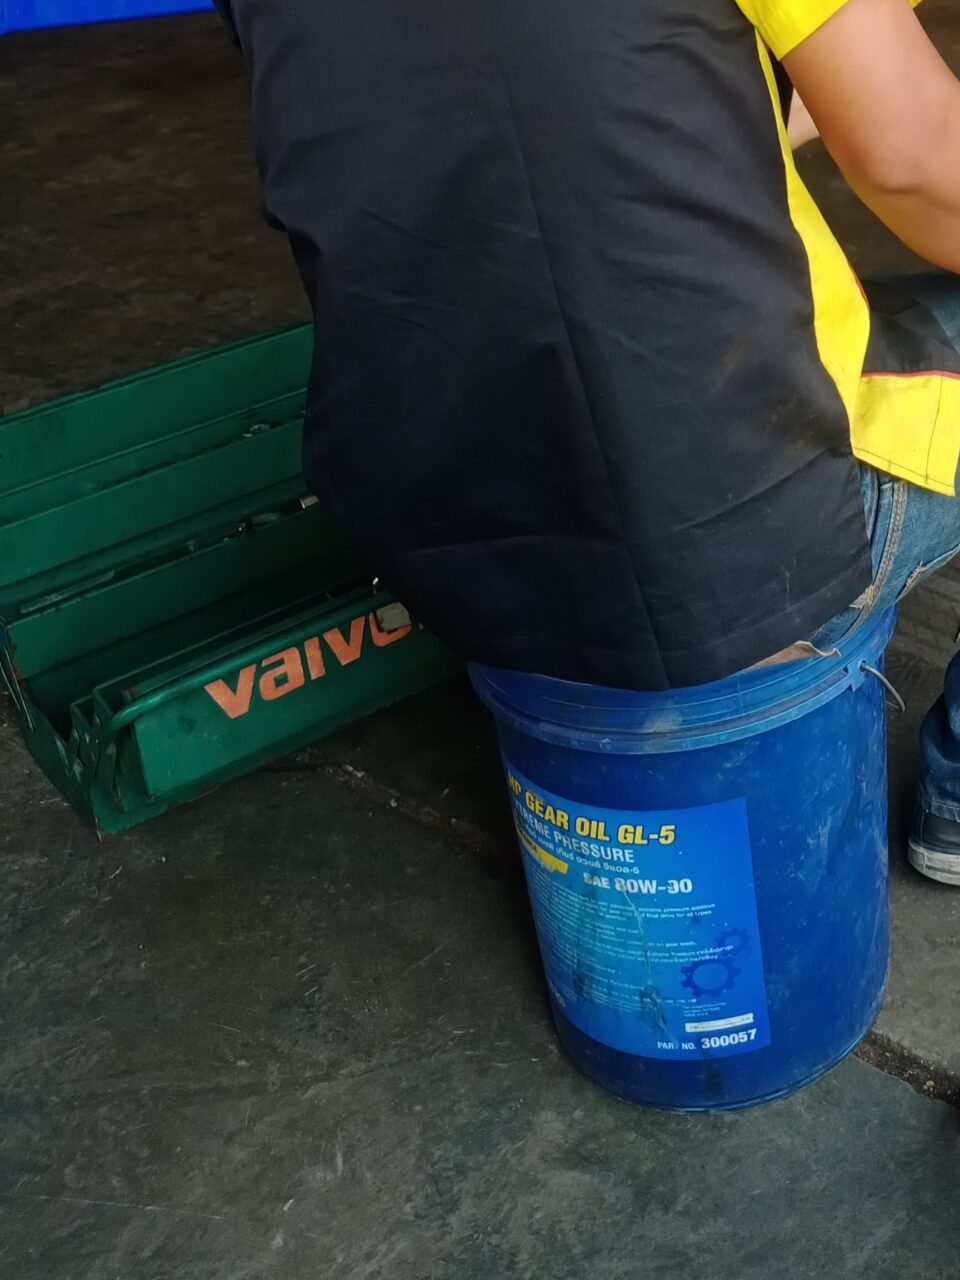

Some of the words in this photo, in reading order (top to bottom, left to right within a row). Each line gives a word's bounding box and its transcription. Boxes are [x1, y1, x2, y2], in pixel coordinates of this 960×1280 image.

[525, 790, 569, 831] GEAR
[575, 816, 610, 842] OIL
[617, 824, 676, 846] GL-5
[553, 830, 636, 863] PRESSURE
[583, 872, 611, 889] SAE
[614, 877, 693, 894] 80W-90
[681, 1041, 697, 1051] NO.
[701, 1028, 758, 1049] 300057
